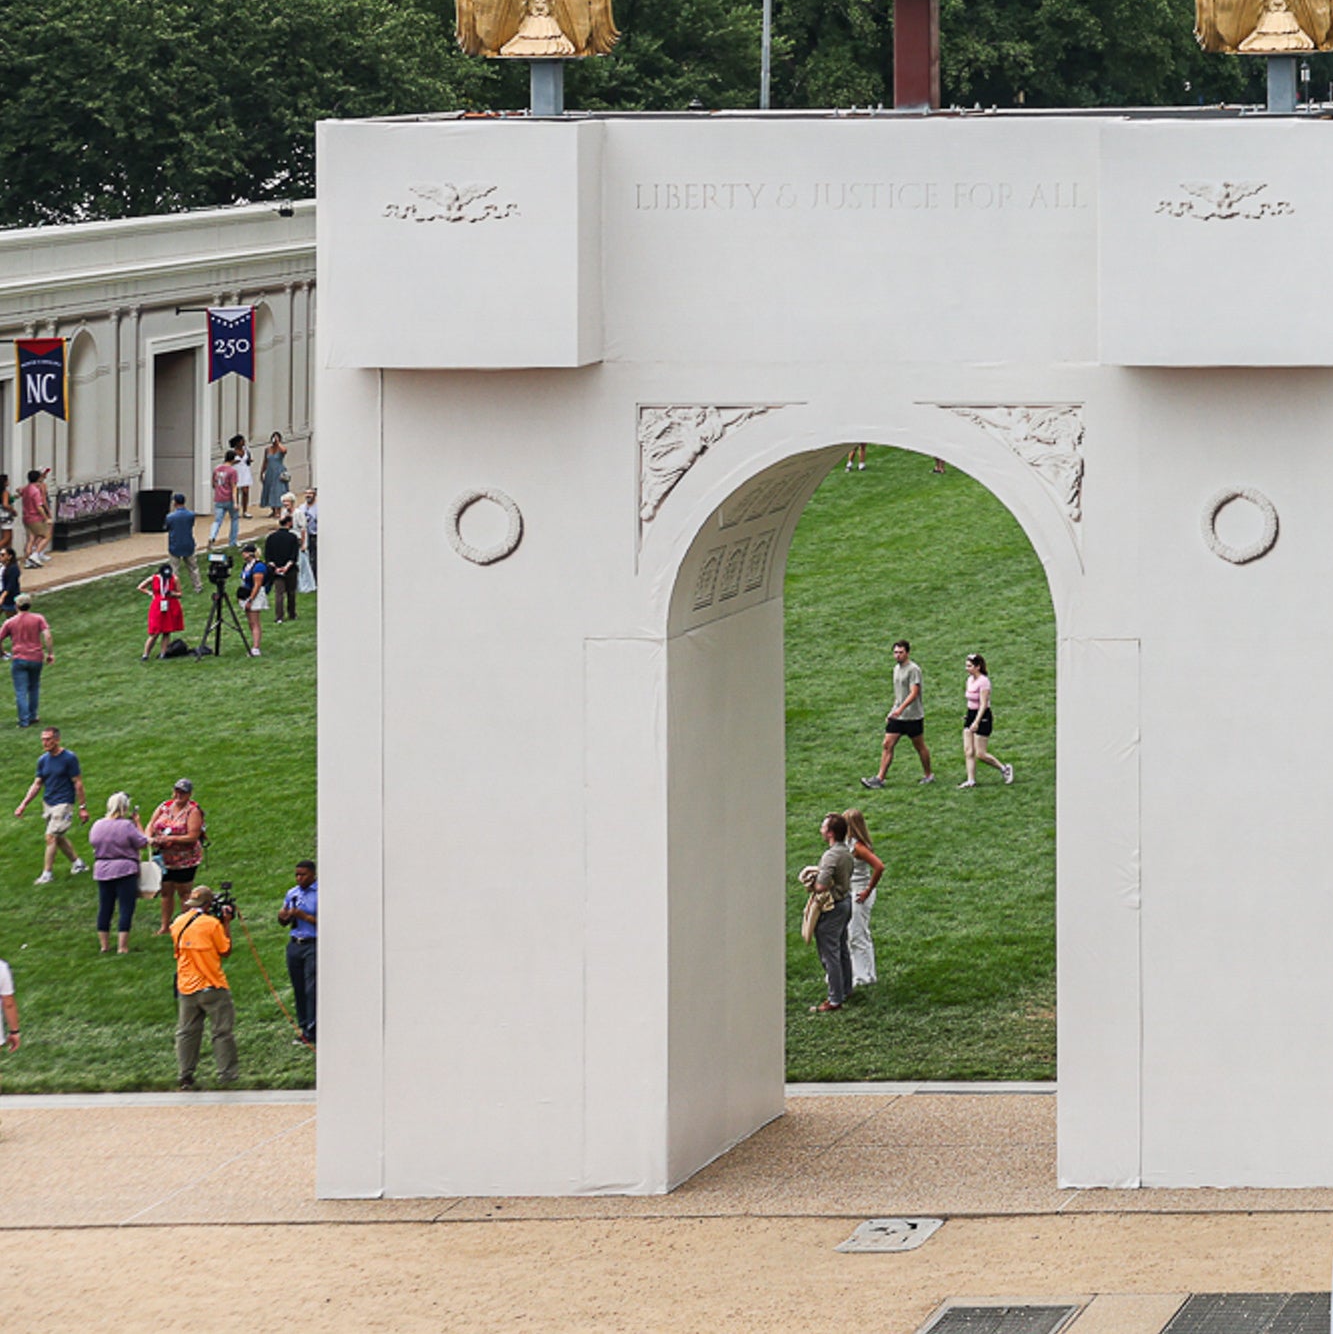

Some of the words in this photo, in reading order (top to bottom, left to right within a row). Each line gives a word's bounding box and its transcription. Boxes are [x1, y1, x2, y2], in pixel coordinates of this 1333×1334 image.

[634, 182, 766, 211] LIBERTY
[774, 182, 798, 210] &
[810, 182, 940, 211] JUSTICE
[953, 182, 1014, 210] FOR
[1027, 182, 1089, 210] ALL
[214, 338, 251, 359] 250
[26, 373, 58, 404] NC
